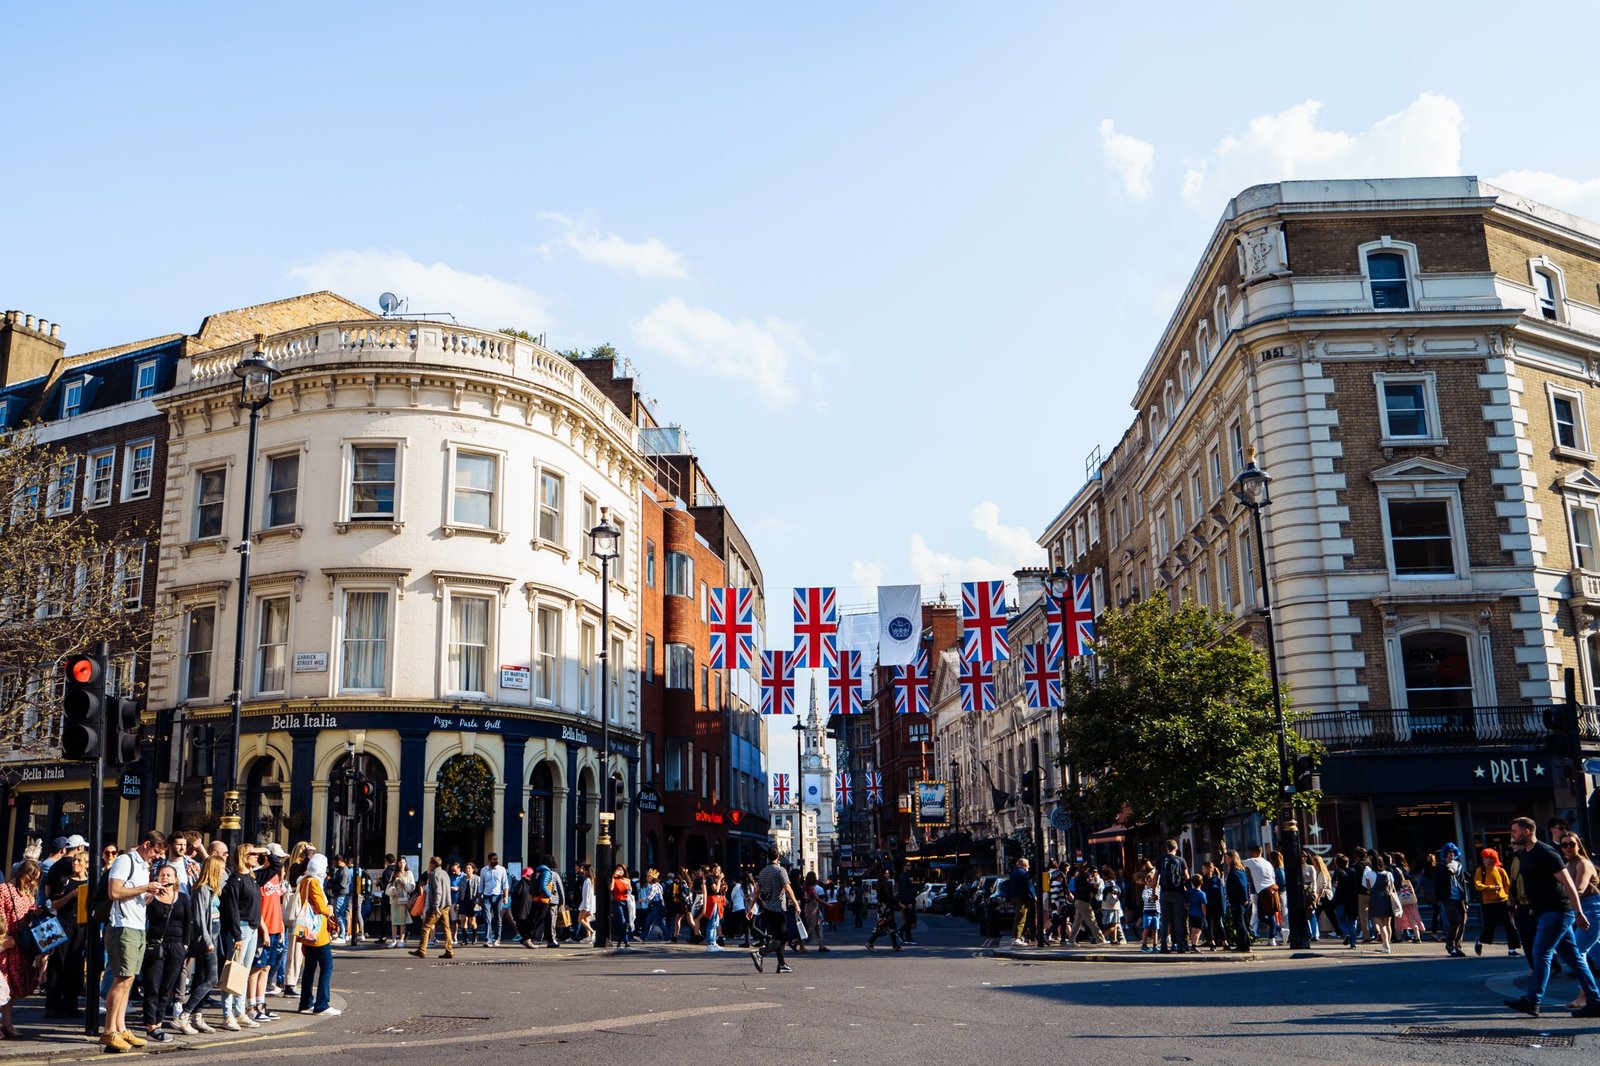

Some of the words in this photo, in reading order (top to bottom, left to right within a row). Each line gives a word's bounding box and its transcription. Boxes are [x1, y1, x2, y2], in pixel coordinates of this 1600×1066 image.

[1261, 347, 1284, 362] 1851
[510, 671, 528, 679] MARTIN'S
[271, 715, 300, 730] Bella
[303, 713, 337, 728] Italia
[433, 715, 453, 728] Pizza
[459, 718, 478, 728] Pasta
[484, 719, 501, 730] Grill
[561, 725, 576, 740] Bella
[575, 728, 588, 743] Italia
[22, 767, 42, 781] Bella
[1490, 758, 1528, 784] PRET
[123, 774, 141, 785] Bella
[122, 785, 141, 795] Italia
[640, 791, 657, 801] Bella
[639, 800, 657, 810] Italia
